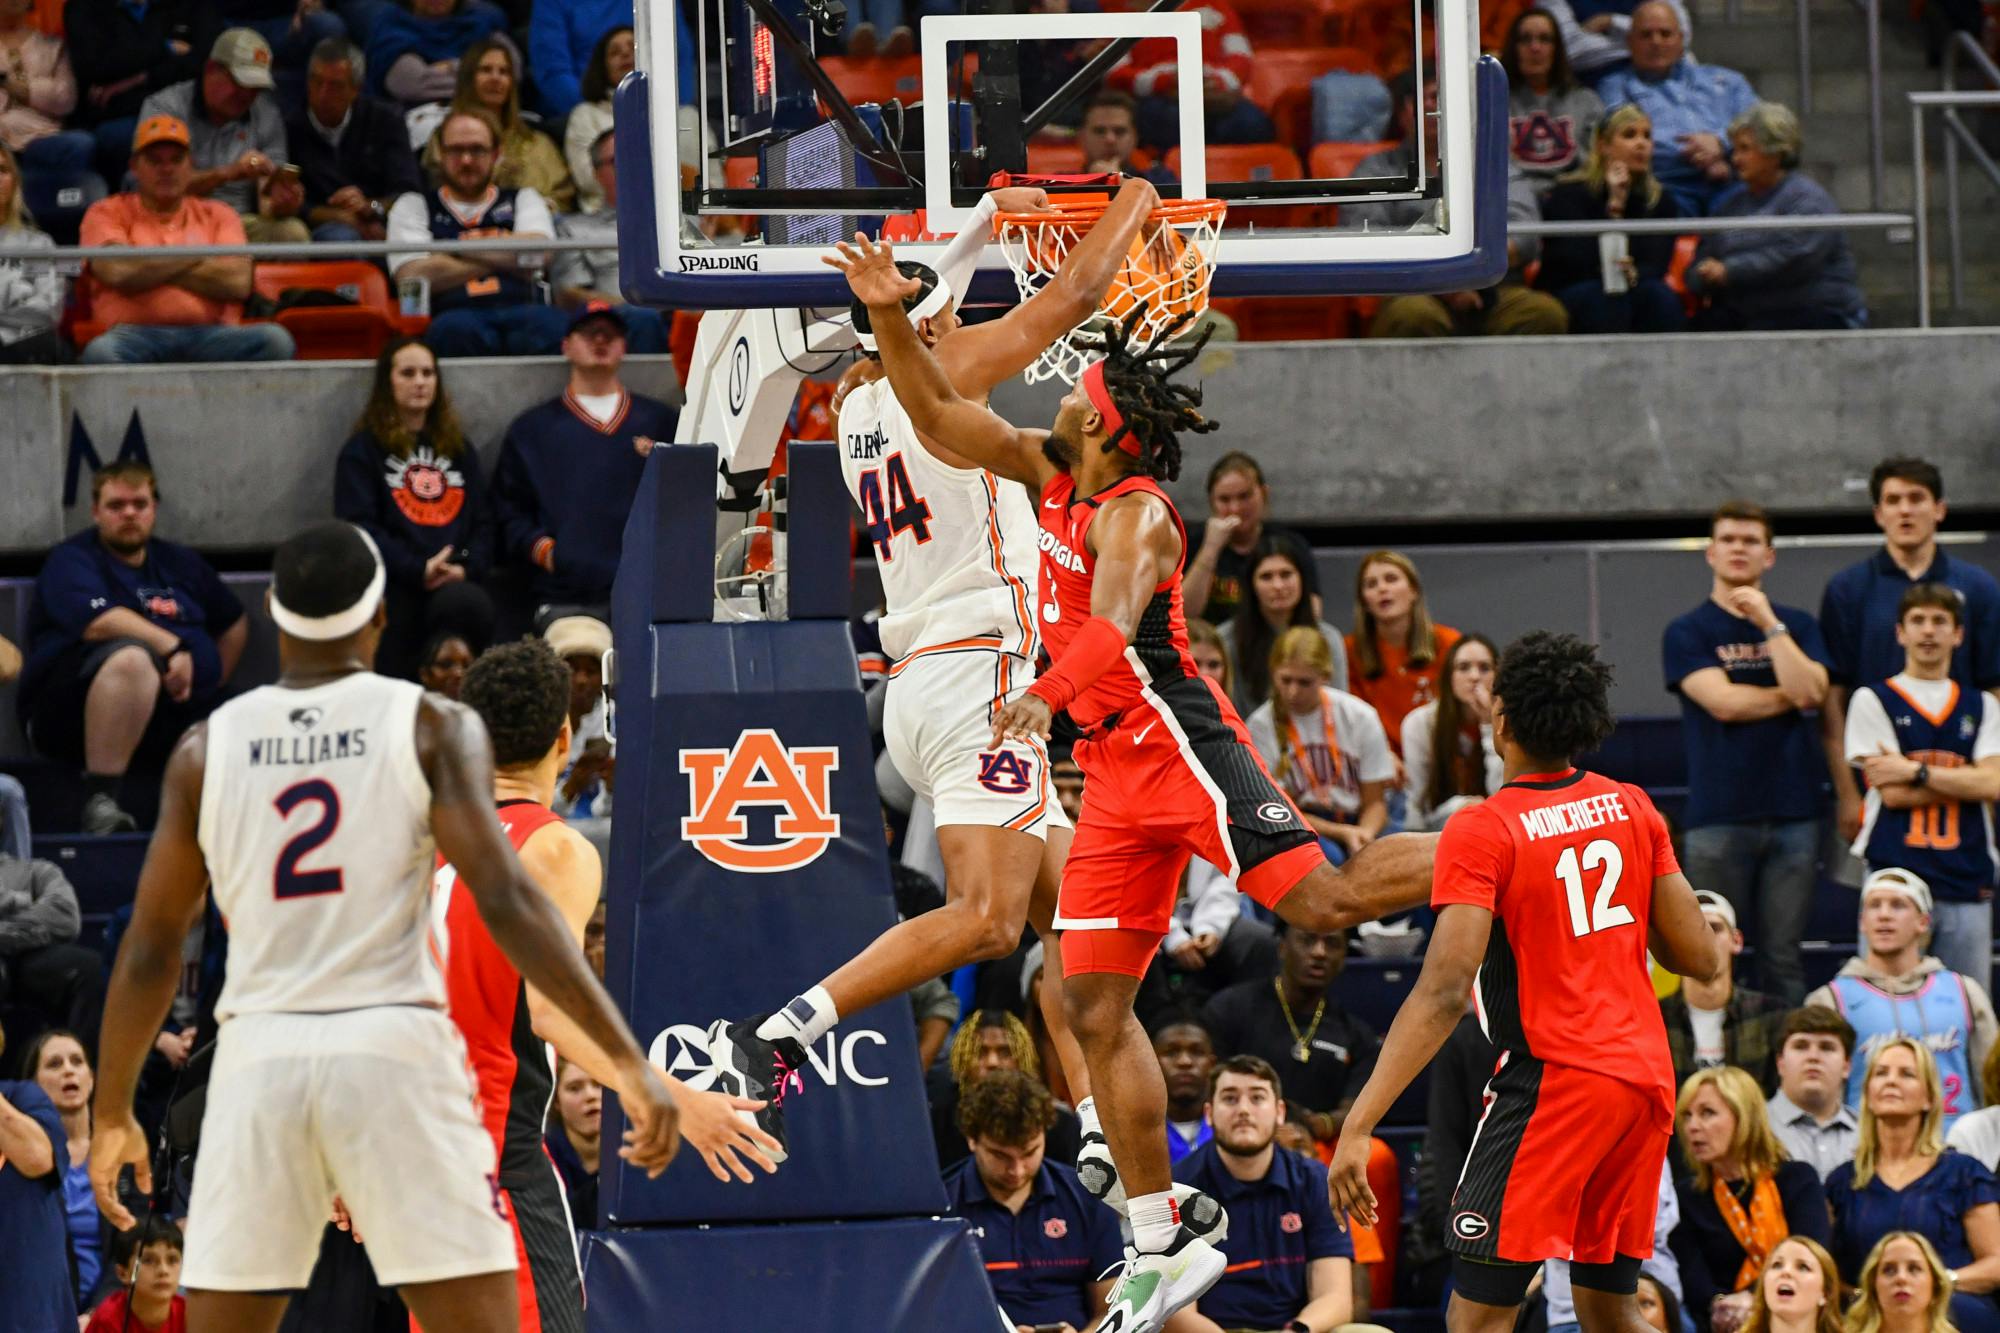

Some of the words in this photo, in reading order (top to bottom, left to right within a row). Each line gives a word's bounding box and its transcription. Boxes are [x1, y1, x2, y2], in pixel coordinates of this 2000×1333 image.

[679, 254, 758, 272] SPALDING
[859, 451, 933, 562] 44
[249, 728, 367, 767] WILLIAMS
[272, 776, 345, 900] 2
[1519, 792, 1630, 841] MONCRIEFFE
[1554, 839, 1637, 938] 12
[789, 1029, 890, 1087] NC
